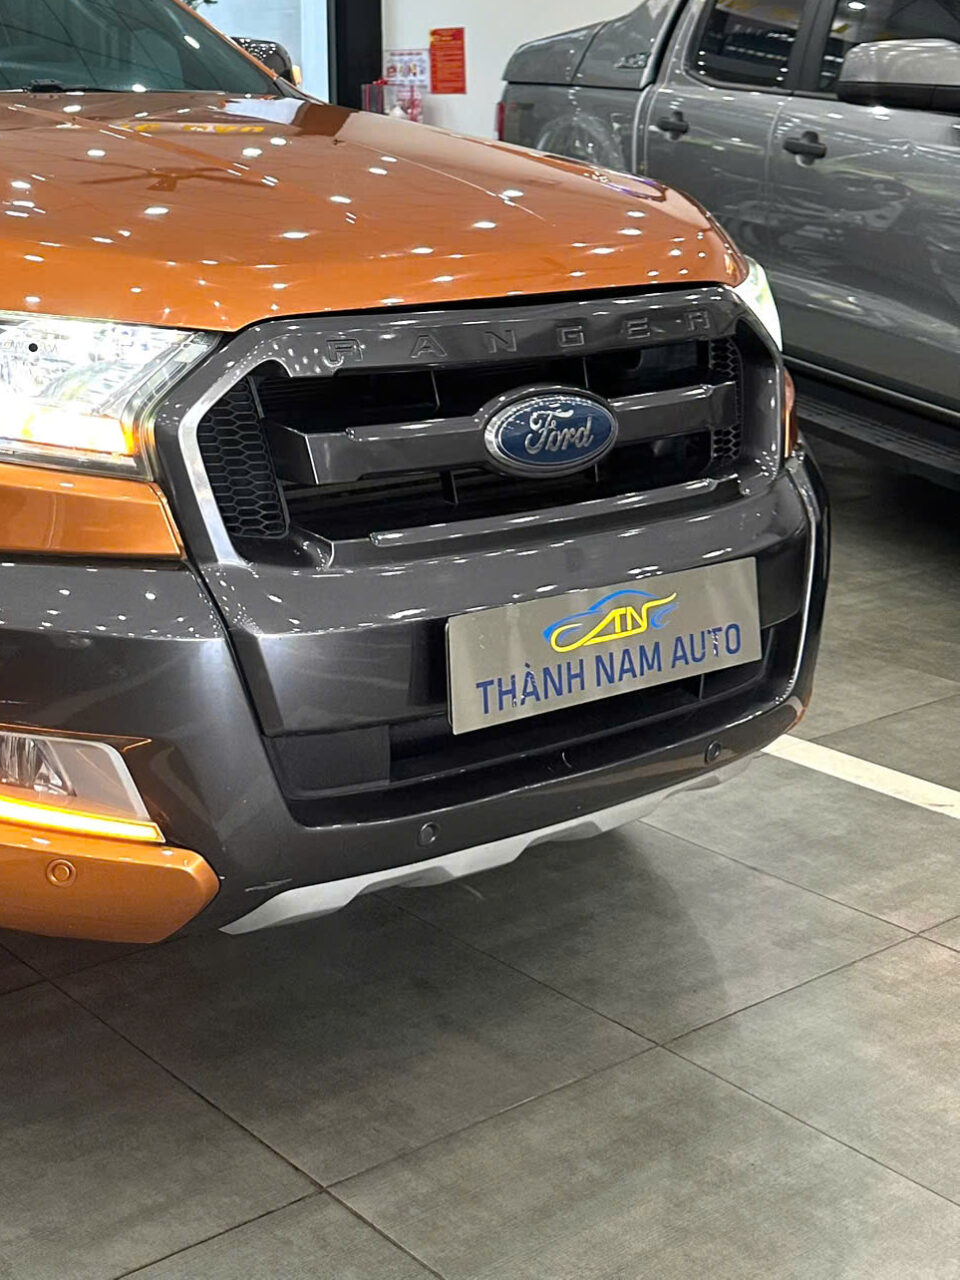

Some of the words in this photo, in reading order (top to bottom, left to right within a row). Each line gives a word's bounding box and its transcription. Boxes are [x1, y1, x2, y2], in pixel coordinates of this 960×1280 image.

[326, 310, 711, 363] RANGER
[524, 409, 594, 455] Ford
[476, 662, 584, 714] THÀNH
[595, 641, 662, 687] NAM
[671, 623, 741, 668] AUTO
